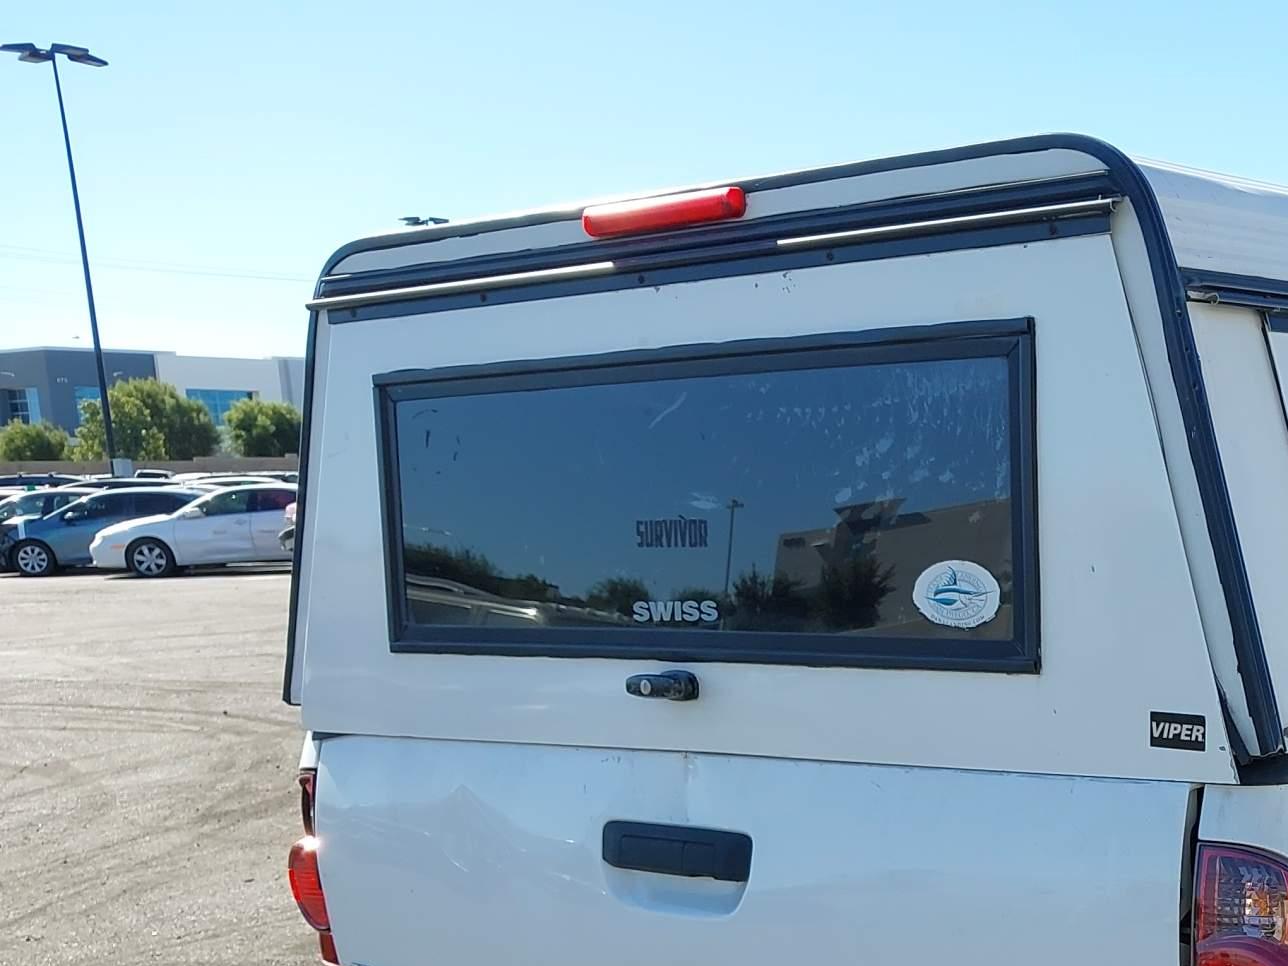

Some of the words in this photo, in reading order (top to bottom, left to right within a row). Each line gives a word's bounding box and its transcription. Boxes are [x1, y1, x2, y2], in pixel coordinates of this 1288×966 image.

[636, 515, 709, 548] SURVIVOR
[632, 600, 719, 622] SWISS
[1151, 721, 1205, 742] VIPER
